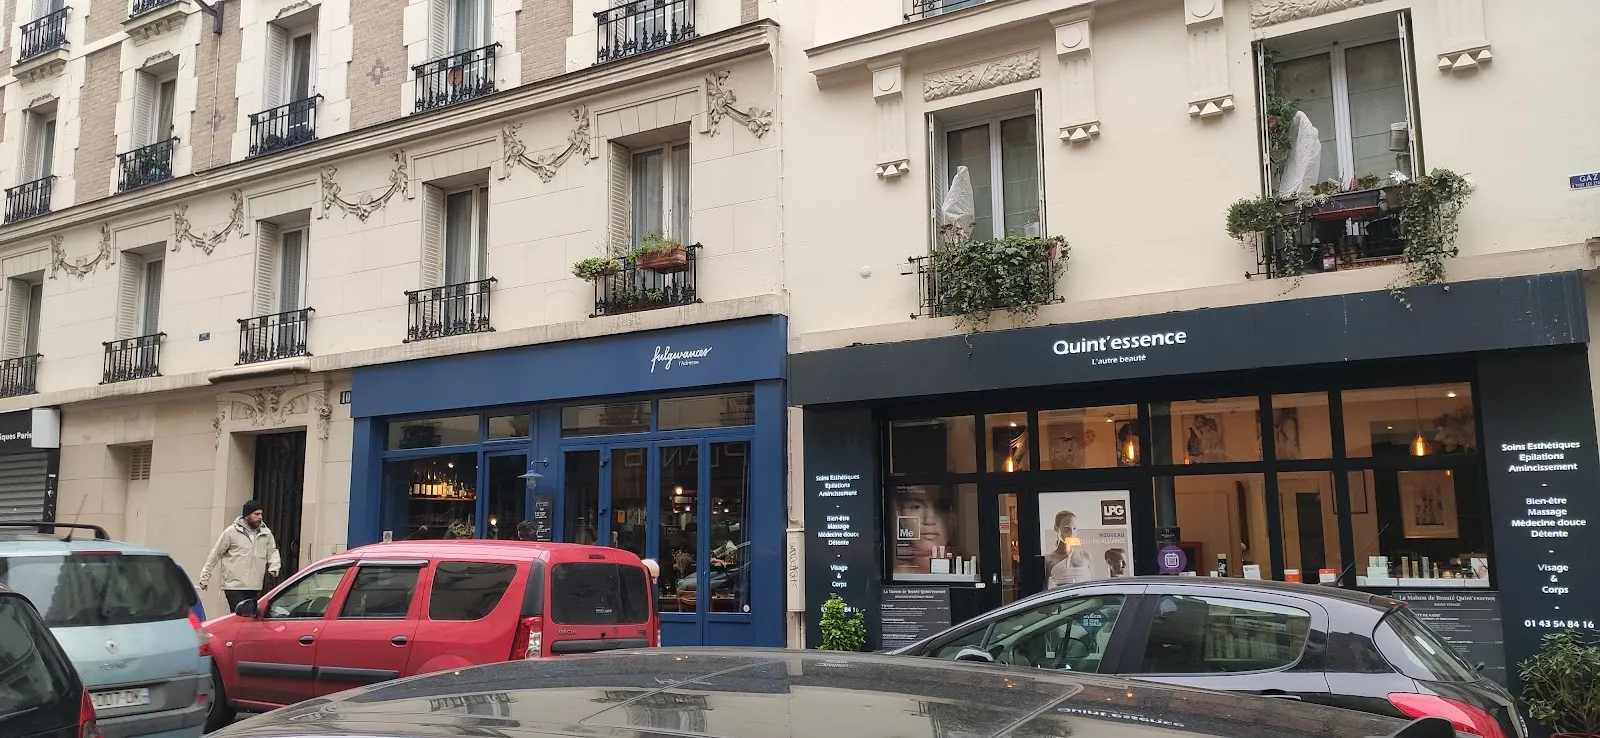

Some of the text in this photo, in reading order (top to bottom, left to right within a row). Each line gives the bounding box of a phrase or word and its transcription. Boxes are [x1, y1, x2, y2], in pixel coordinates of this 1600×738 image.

[1579, 174, 1598, 182] GAZ
[1053, 331, 1187, 355] Quint'essence
[1092, 354, 1147, 365] L'autre beauté
[342, 391, 351, 404] 10
[17, 431, 32, 439] Paris
[1527, 441, 1580, 450] Esthétiques
[1519, 453, 1564, 462] Epilations
[1508, 463, 1578, 472] Amincissement
[1526, 497, 1567, 505] Bien-être
[1103, 505, 1124, 516] LPG
[1527, 509, 1568, 517] Massage
[1511, 519, 1556, 527] Médecine
[900, 529, 914, 537] Me
[1531, 530, 1569, 538] Détente
[1537, 564, 1569, 573] Visage
[1542, 586, 1569, 595] Corps
[1524, 620, 1595, 629] 01 43 56 84 16
